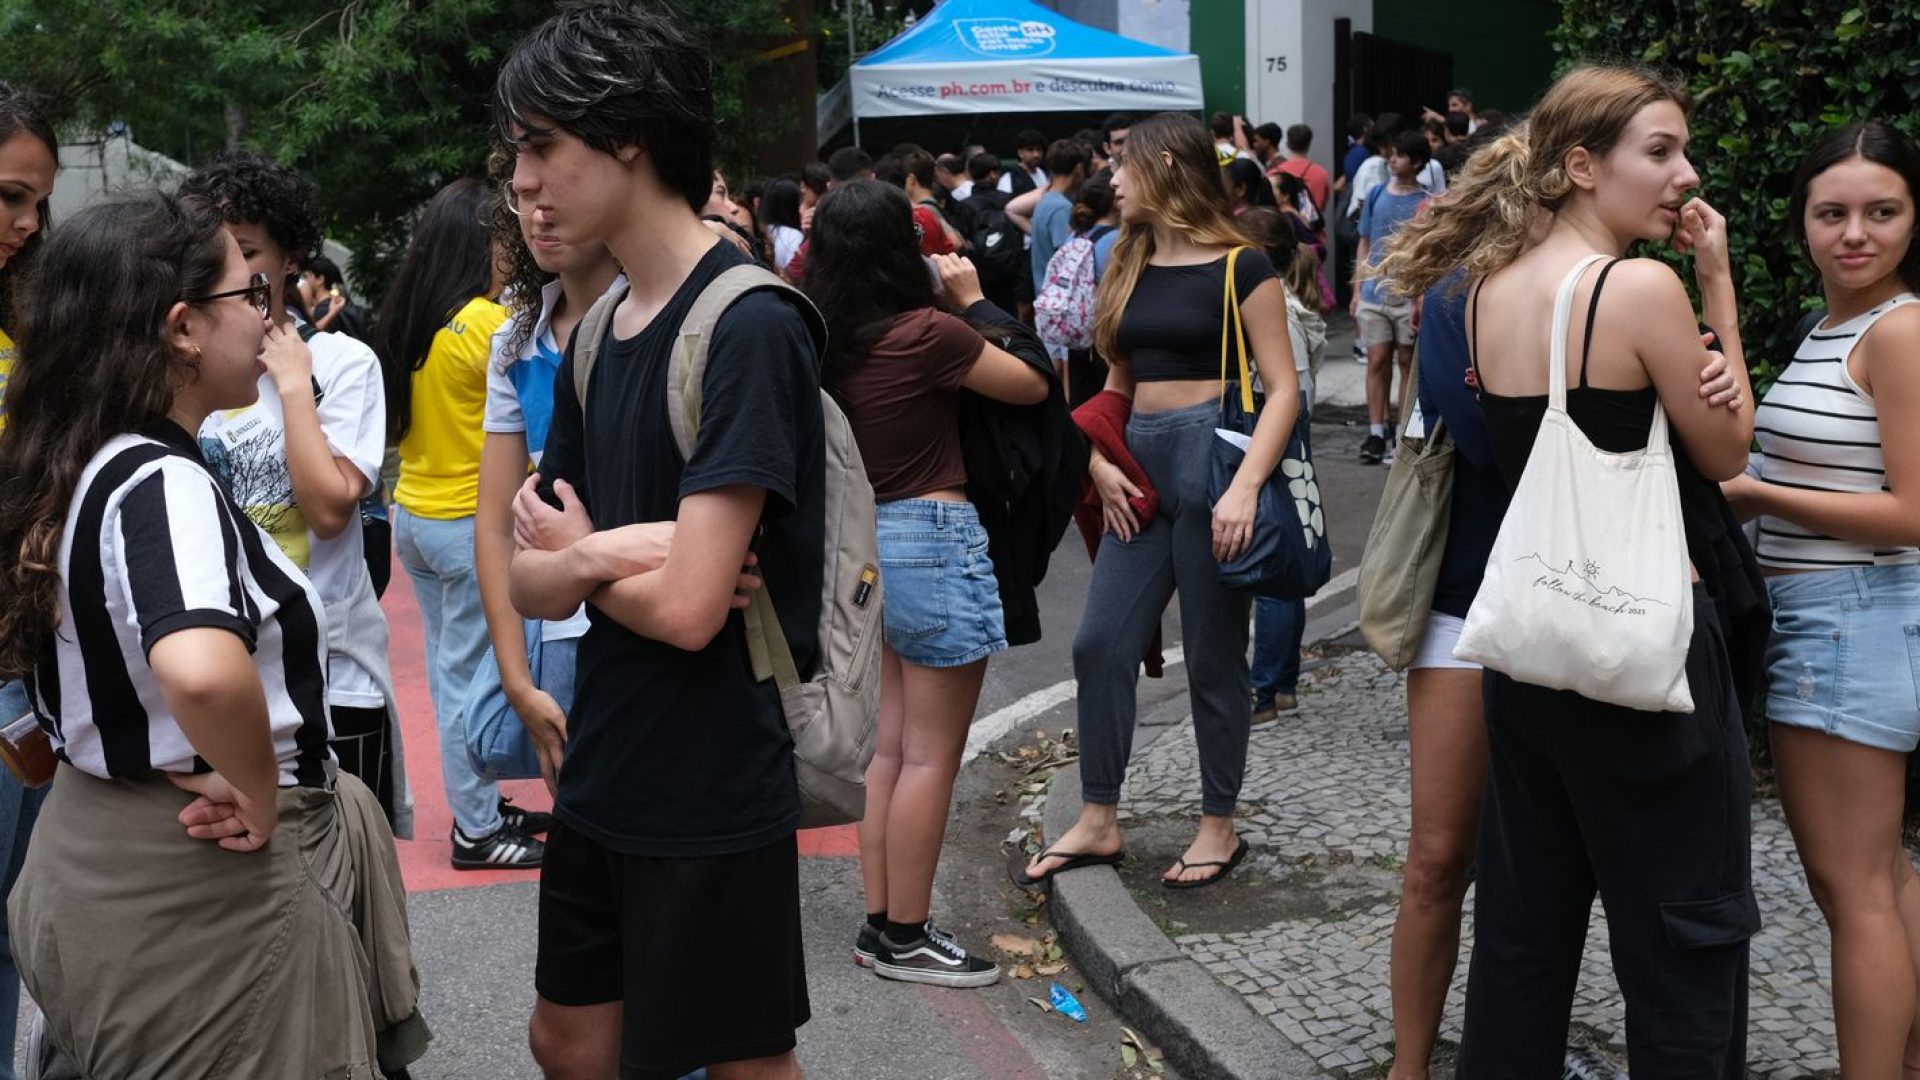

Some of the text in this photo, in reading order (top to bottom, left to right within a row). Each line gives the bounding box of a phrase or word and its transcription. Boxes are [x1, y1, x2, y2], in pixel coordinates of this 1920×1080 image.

[1265, 56, 1288, 74] 75
[877, 78, 1176, 100] Acesse ph.com.br e descubra como
[1532, 575, 1573, 595] follow
[1573, 592, 1589, 604] the
[1589, 596, 1629, 614] beach
